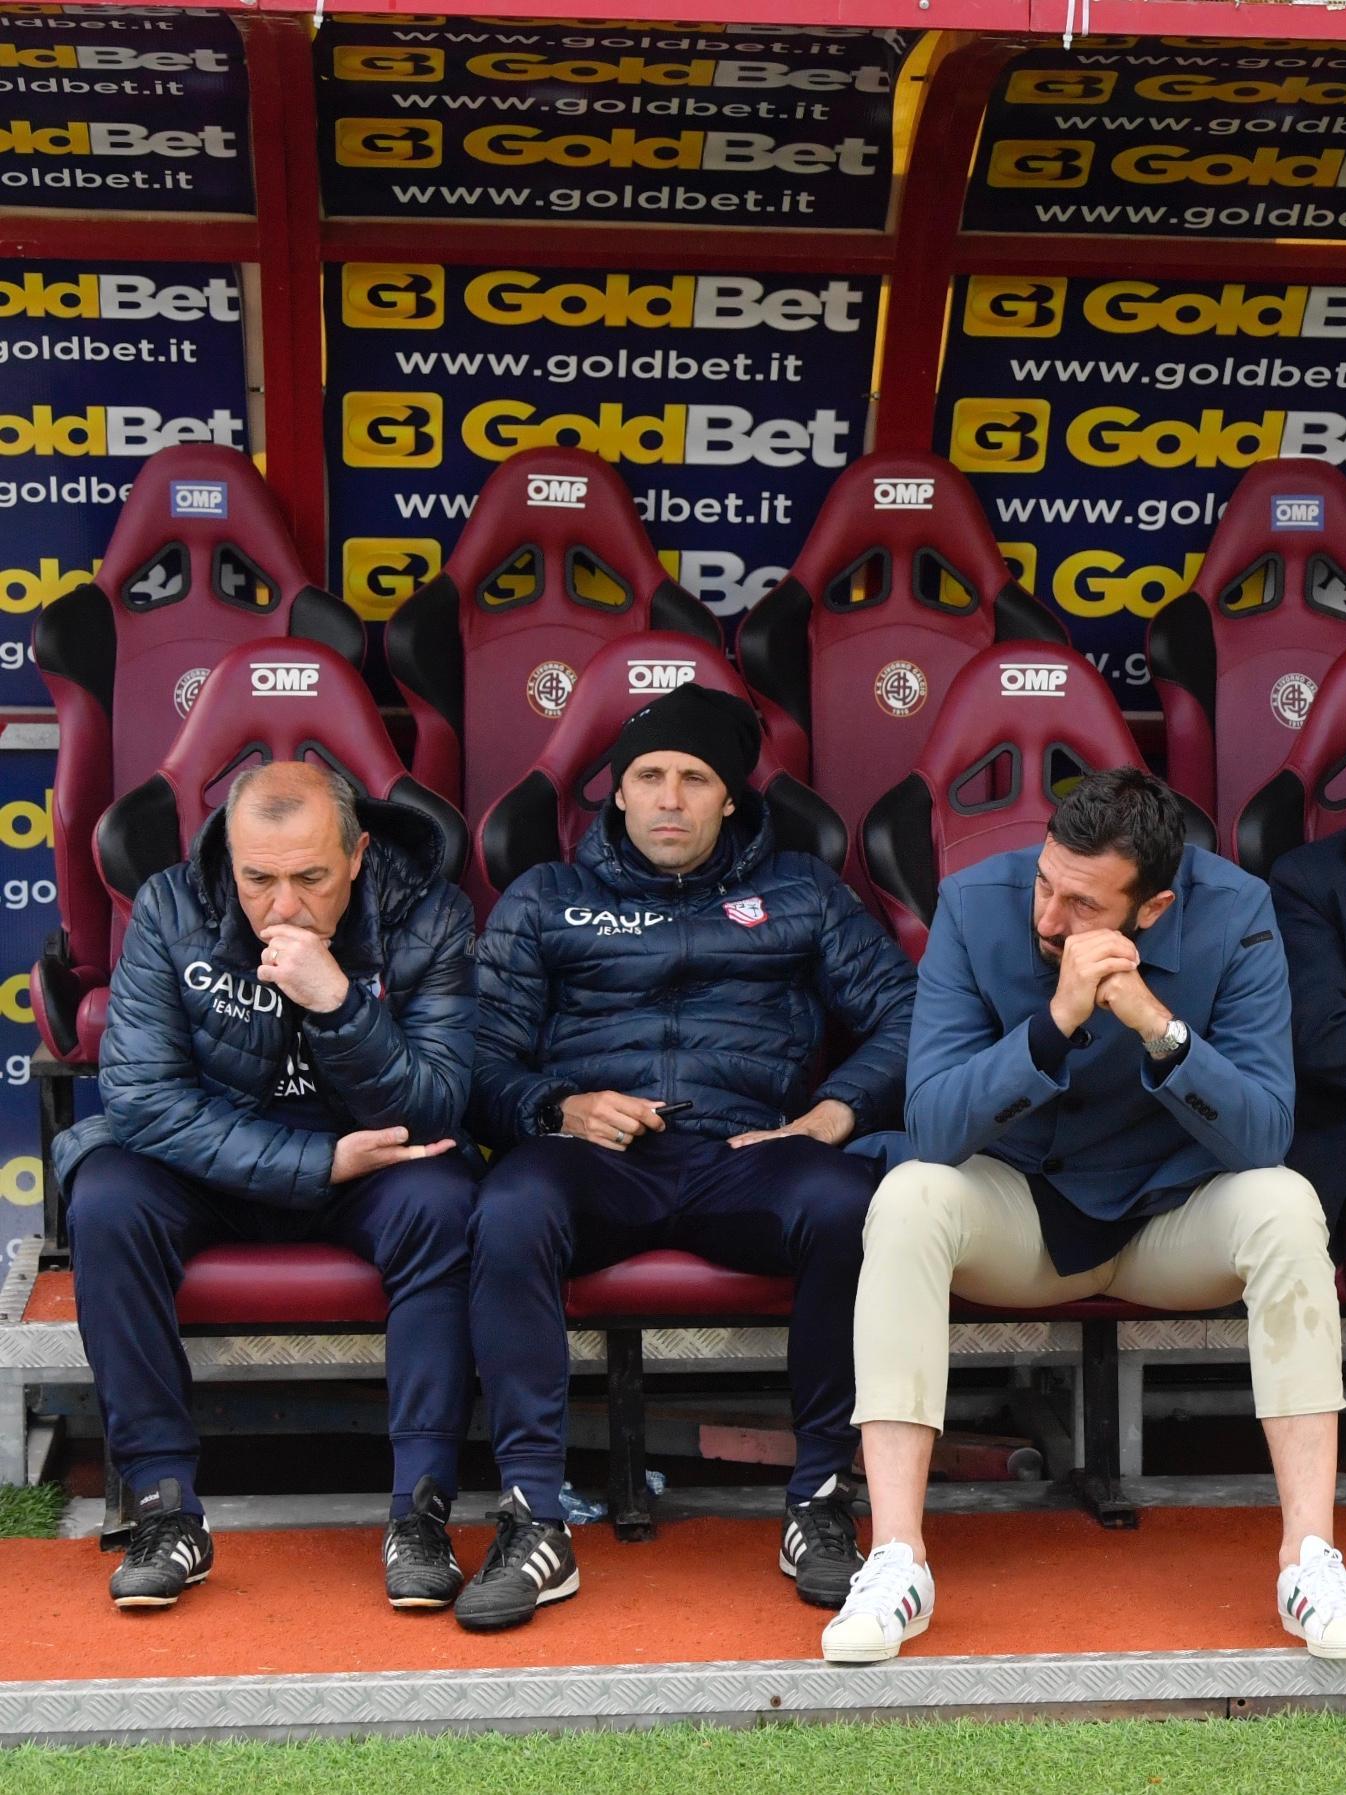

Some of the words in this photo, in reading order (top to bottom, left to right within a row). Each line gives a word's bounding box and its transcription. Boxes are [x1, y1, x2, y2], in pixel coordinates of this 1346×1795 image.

[0, 17, 174, 31] ldbet.it
[392, 31, 847, 55] www.goldbet.it
[0, 43, 229, 73] ldBet
[466, 52, 890, 94] GoldBet
[0, 77, 184, 96] ldbet.it
[392, 93, 830, 121] www.goldbet.it
[464, 124, 879, 176] GoldBet
[1, 168, 194, 190] oldbet.it
[392, 185, 816, 213] www.goldbet.it
[464, 270, 863, 332] GoldBet
[395, 349, 802, 382] www.goldbet.it
[0, 405, 243, 456] oldBet
[461, 400, 849, 467] GoldBet
[176, 489, 222, 508] OMP
[527, 479, 587, 502] OMP
[874, 483, 934, 505] OMP
[1276, 503, 1319, 523] OMP
[250, 668, 320, 691] OMP
[628, 666, 695, 687] OMP
[1000, 669, 1067, 692] OMP
[565, 907, 673, 927] GAUD
[596, 926, 642, 936] JEANS
[184, 961, 283, 1018] GAUDI
